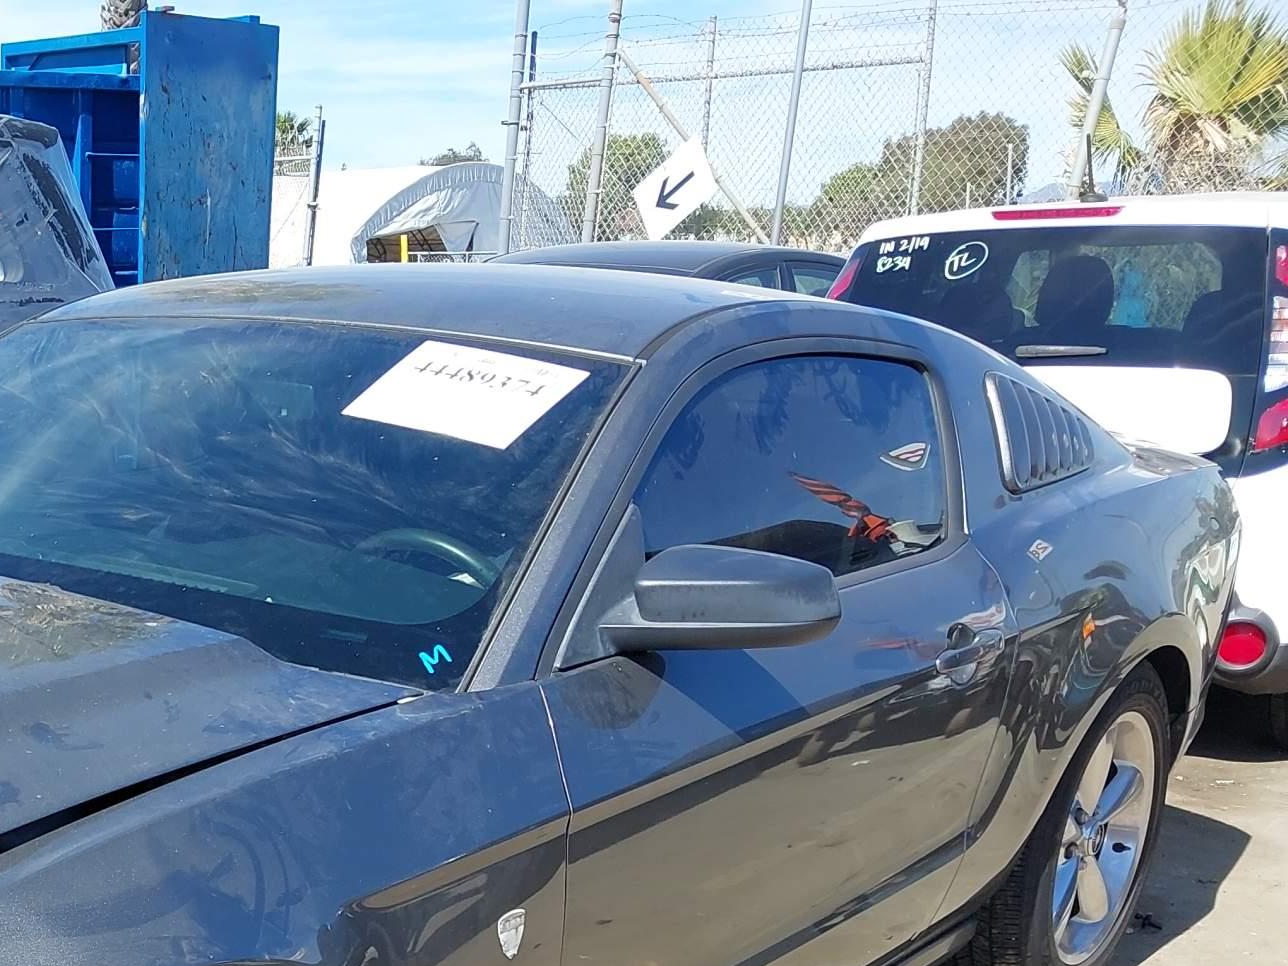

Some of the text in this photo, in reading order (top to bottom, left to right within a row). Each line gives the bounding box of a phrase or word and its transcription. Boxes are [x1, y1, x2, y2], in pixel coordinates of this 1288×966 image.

[879, 236, 931, 255] IN 2/19
[876, 256, 912, 273] 8234
[948, 252, 977, 272] TL
[414, 361, 547, 397] 44489374
[418, 645, 452, 674] M
